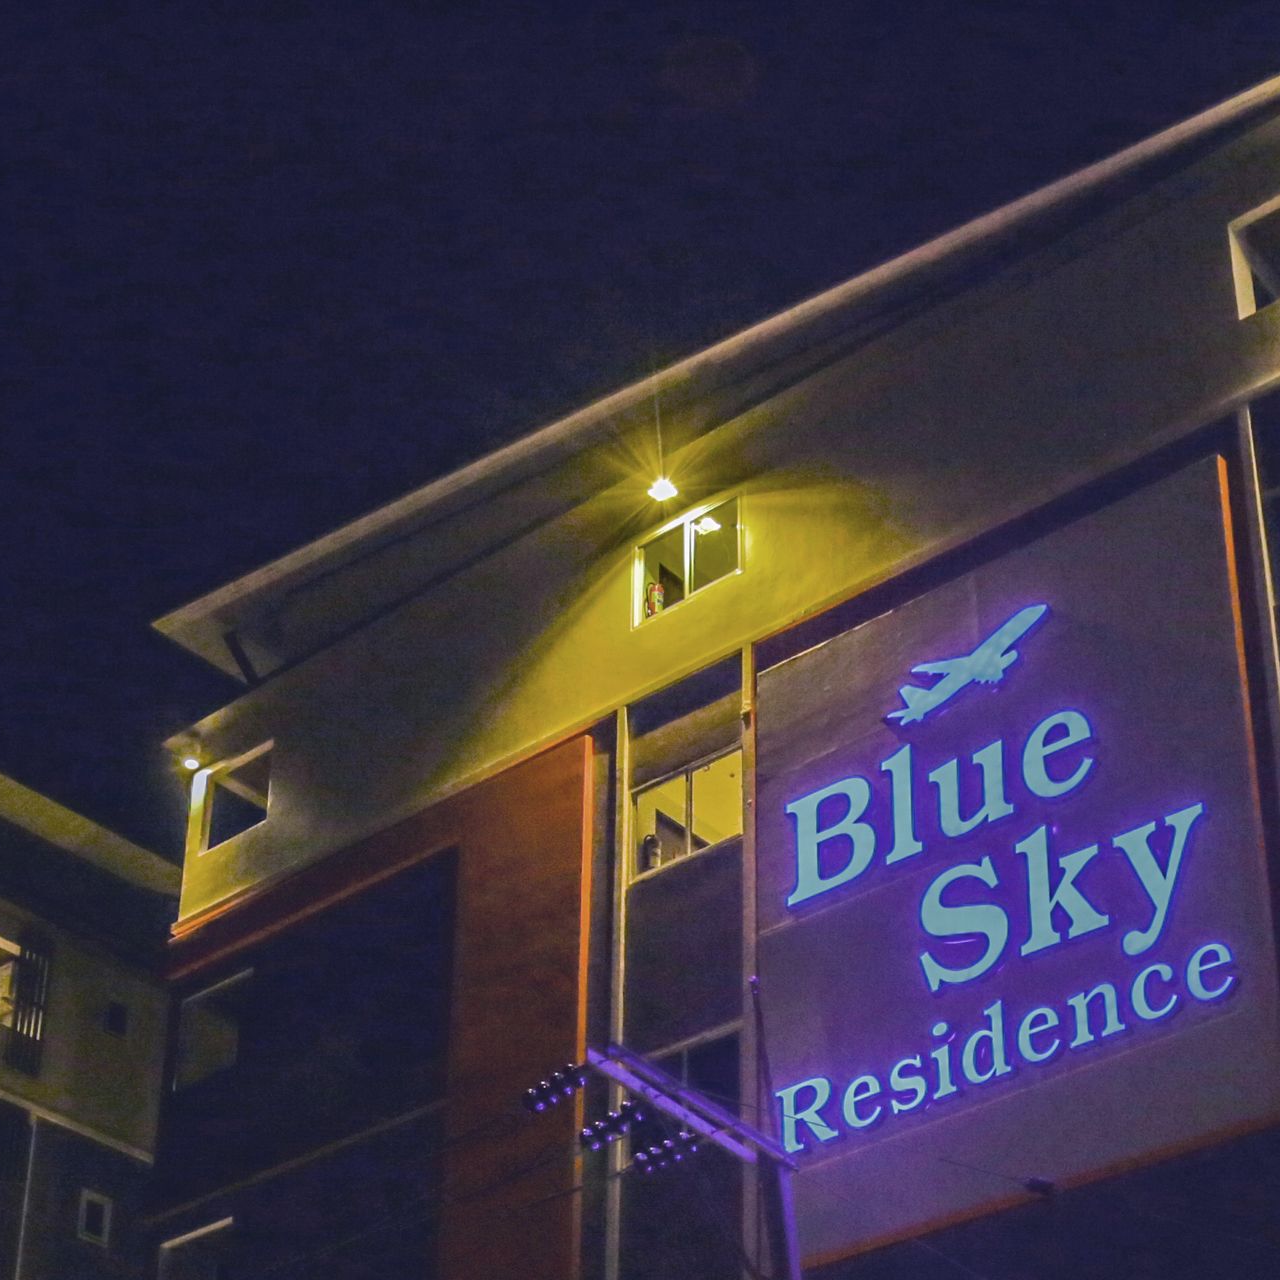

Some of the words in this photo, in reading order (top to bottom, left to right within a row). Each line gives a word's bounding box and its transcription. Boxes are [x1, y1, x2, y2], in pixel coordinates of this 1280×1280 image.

[786, 709, 1094, 907] Blue
[919, 802, 1204, 993] Sky
[775, 941, 1233, 1153] Residence
